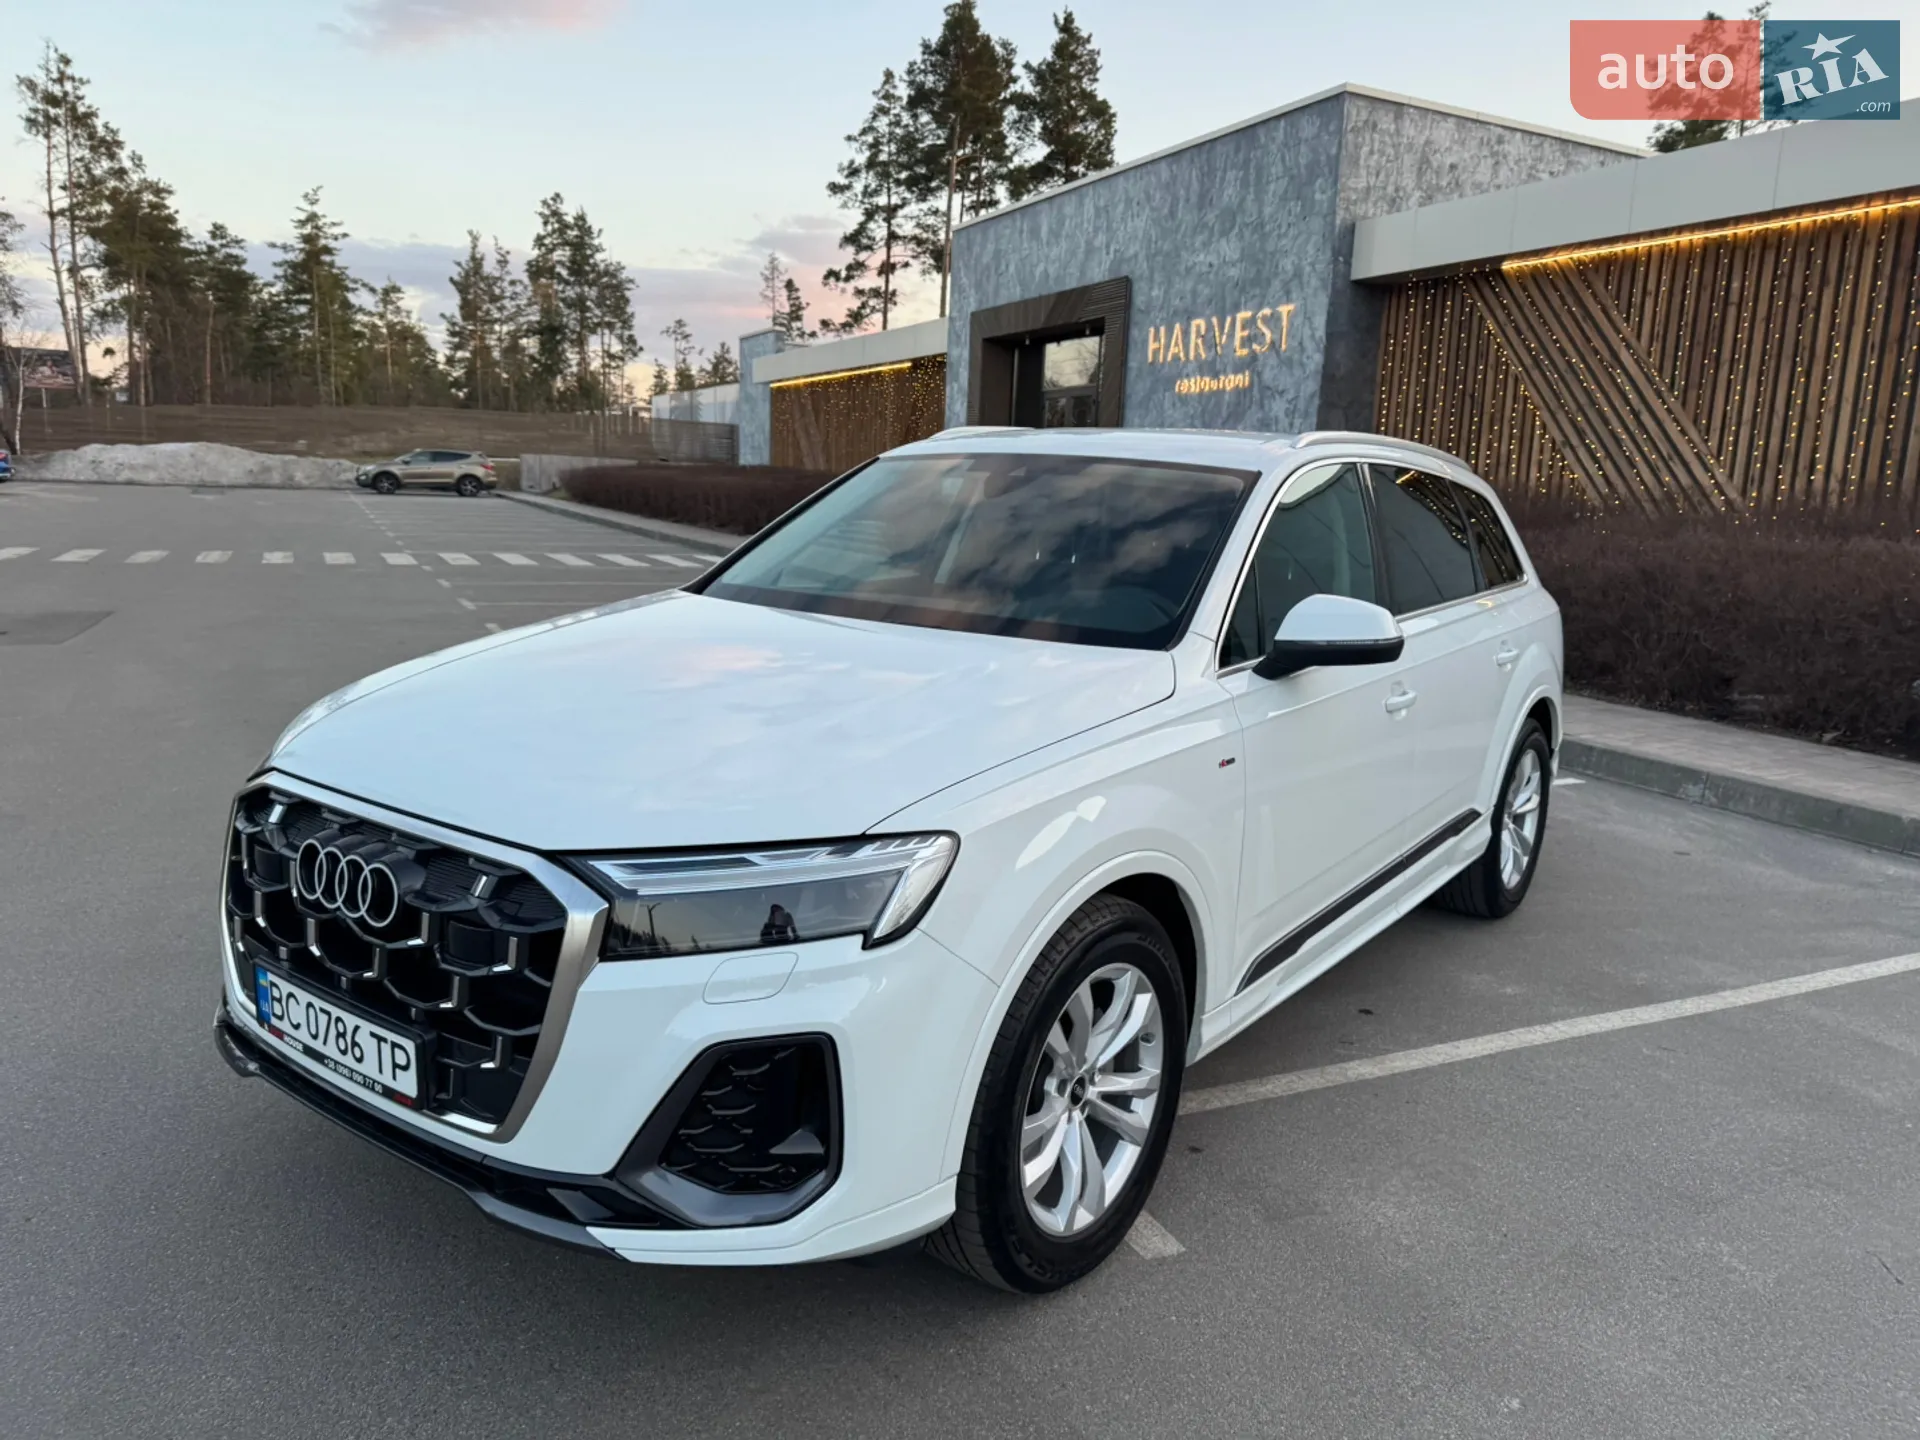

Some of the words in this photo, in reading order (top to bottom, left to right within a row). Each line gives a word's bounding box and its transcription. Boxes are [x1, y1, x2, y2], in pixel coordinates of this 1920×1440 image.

[1147, 303, 1296, 365] HARVEST
[269, 978, 302, 1031] BC
[305, 1001, 365, 1065] 0786
[369, 1030, 412, 1082] TP
